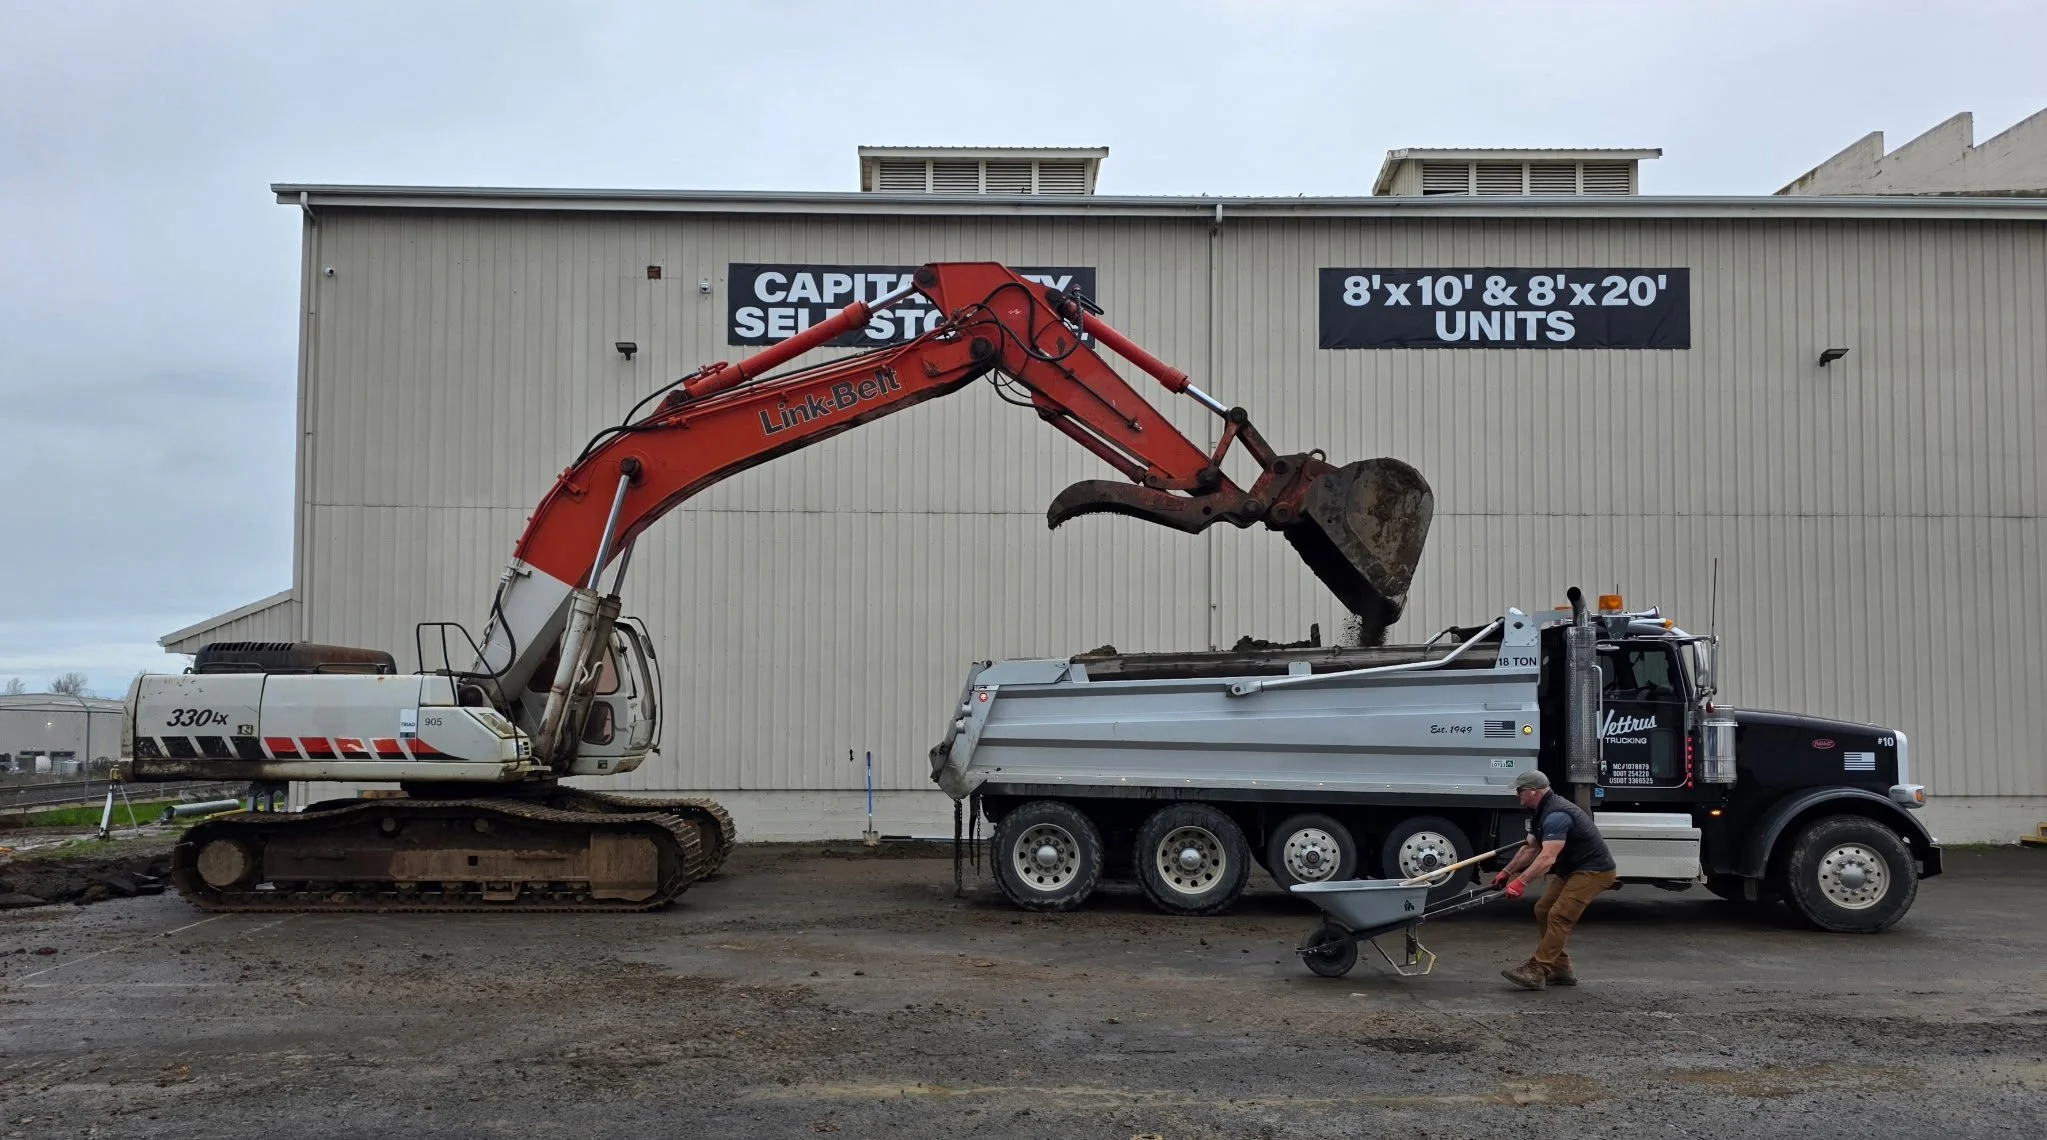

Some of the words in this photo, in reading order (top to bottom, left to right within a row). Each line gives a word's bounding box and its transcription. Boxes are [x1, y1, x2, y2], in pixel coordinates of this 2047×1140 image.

[754, 271, 934, 304] CAPITA
[1482, 275, 1519, 306] &
[734, 306, 844, 338] SEL
[1435, 310, 1576, 341] UNITS
[758, 366, 902, 436] Link-Belt
[1498, 657, 1509, 667] 18
[1512, 657, 1537, 667] TON
[424, 717, 442, 726] 905
[1450, 725, 1473, 734] 1949
[1596, 709, 1658, 740] Vettrus
[1877, 736, 1894, 747] #10
